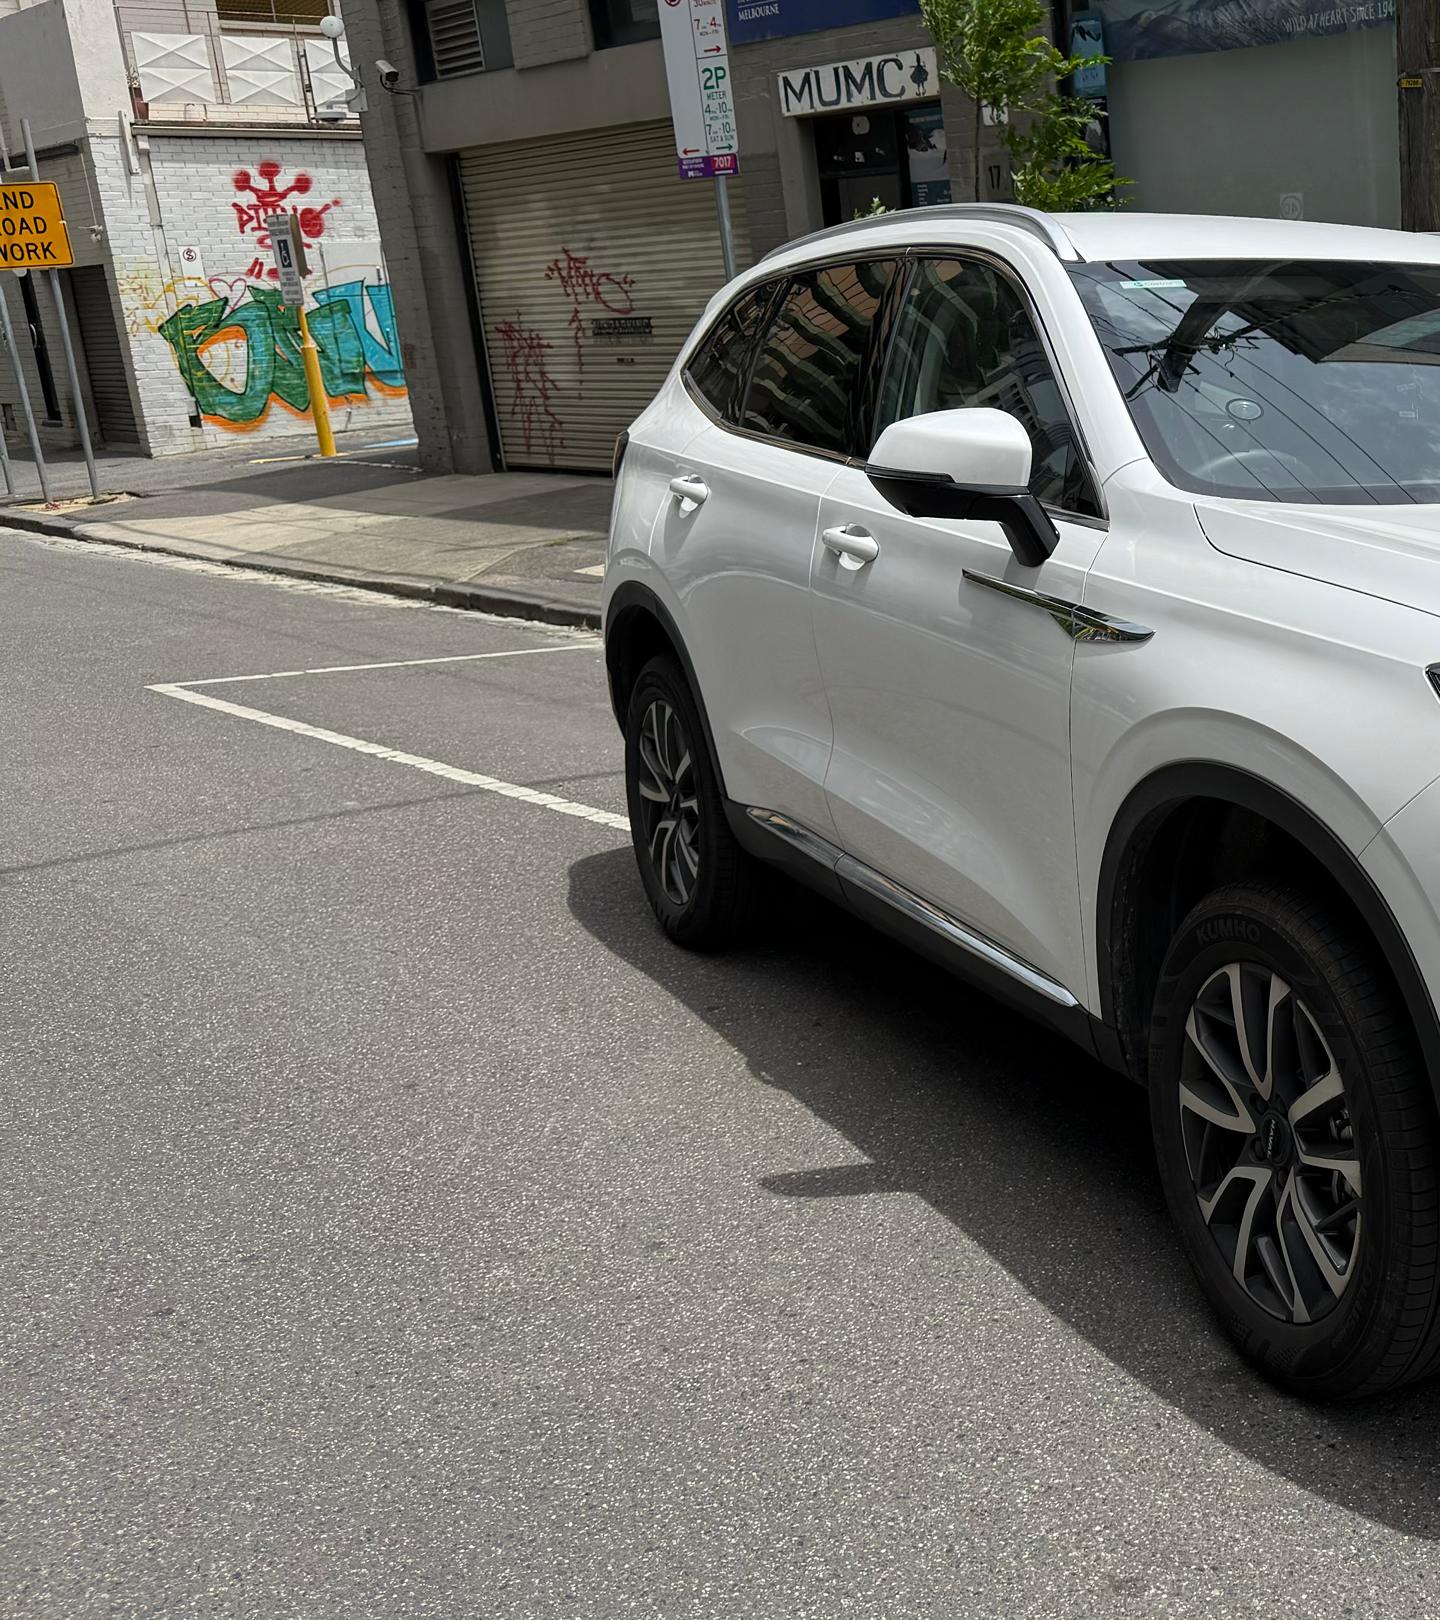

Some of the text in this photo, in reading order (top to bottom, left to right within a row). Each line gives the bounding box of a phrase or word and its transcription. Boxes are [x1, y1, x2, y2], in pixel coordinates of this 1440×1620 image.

[738, 3, 780, 21] MELBOURNE
[1281, 15, 1306, 33] WILD
[1320, 8, 1348, 27] HEART
[702, 66, 726, 90] 2P
[782, 58, 906, 113] MUMC
[707, 91, 727, 100] METER
[714, 156, 731, 169] 7017
[988, 165, 1001, 191] 17
[0, 191, 34, 210] ND
[0, 217, 47, 235] OAD
